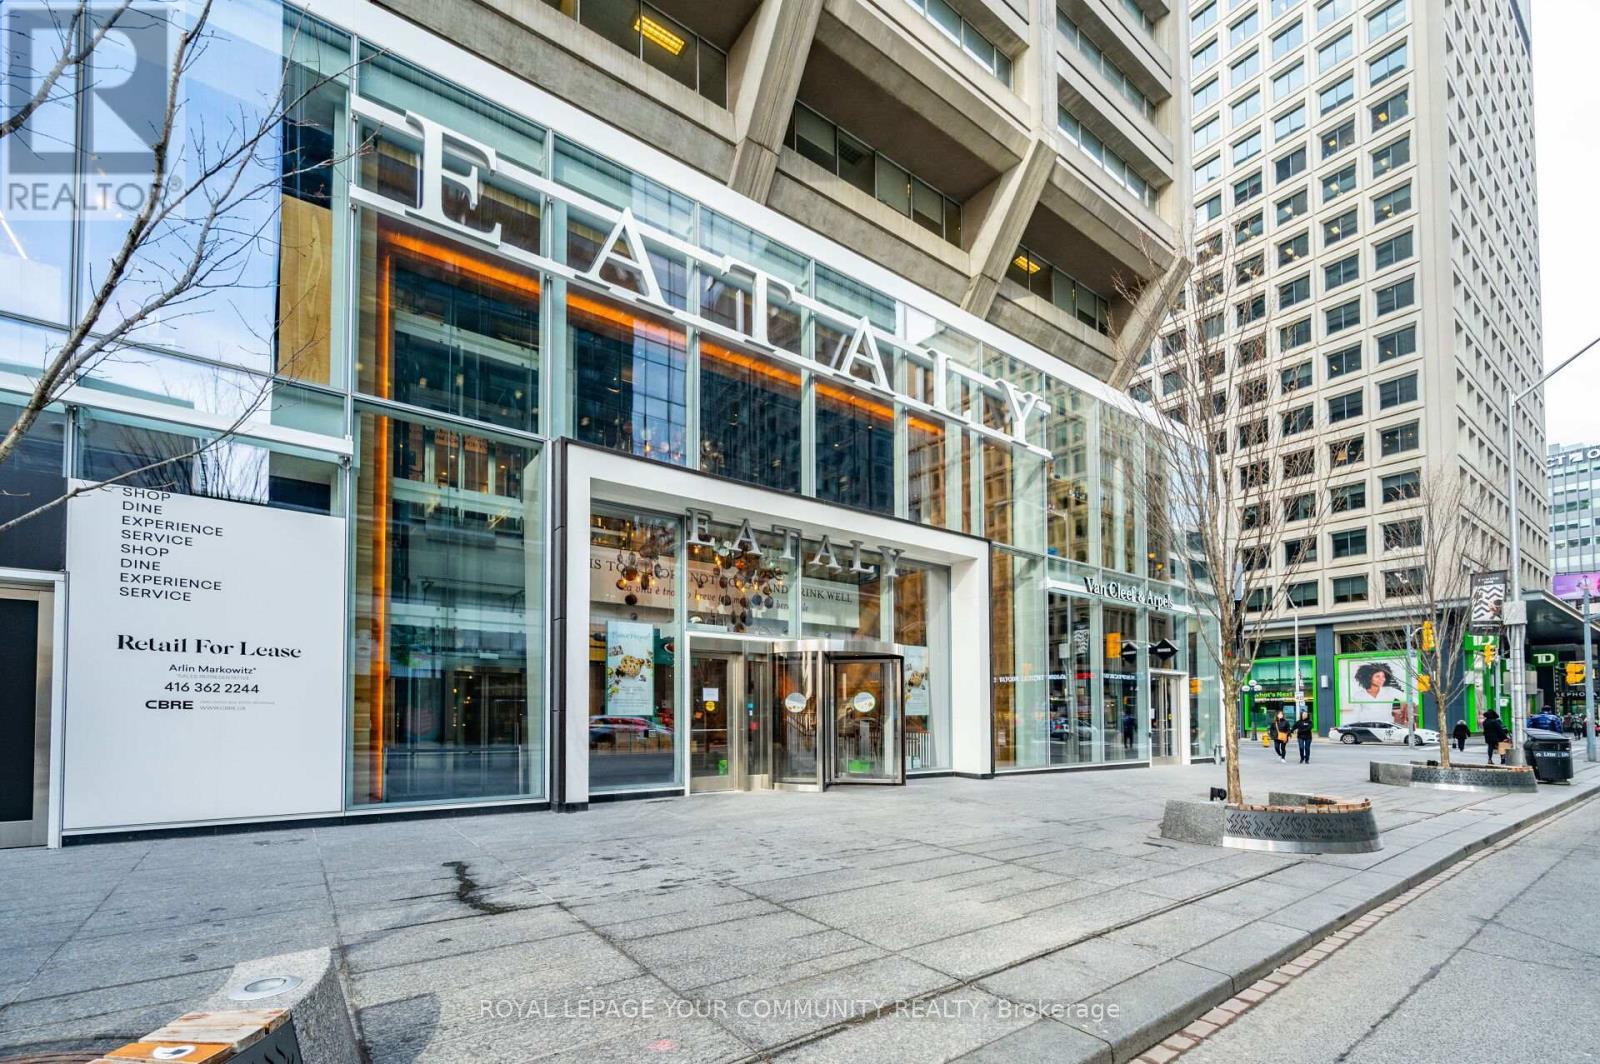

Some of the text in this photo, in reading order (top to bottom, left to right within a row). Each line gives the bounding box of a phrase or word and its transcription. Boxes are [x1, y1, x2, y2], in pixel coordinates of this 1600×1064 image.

[405, 112, 1051, 457] EATALY
[122, 487, 171, 501] SHOP
[122, 501, 162, 515] DINE
[121, 515, 224, 537] EXPERIENCE
[121, 529, 193, 546] SERVICE
[686, 507, 905, 577] EATALY
[120, 543, 169, 556] SHOP
[120, 558, 160, 571] DINE
[120, 572, 222, 591] EXPERIENCE
[119, 586, 192, 601] SERVICE
[827, 591, 853, 603] WELL
[1084, 576, 1108, 597] Van
[1107, 582, 1137, 603] Cleef
[1146, 590, 1174, 611] Arpels
[117, 634, 302, 658] Retail For Lease
[1533, 653, 1556, 664] TD
[168, 664, 196, 673] Arlin
[164, 682, 260, 694] 416 362 2244
[145, 700, 194, 710] CBRE
